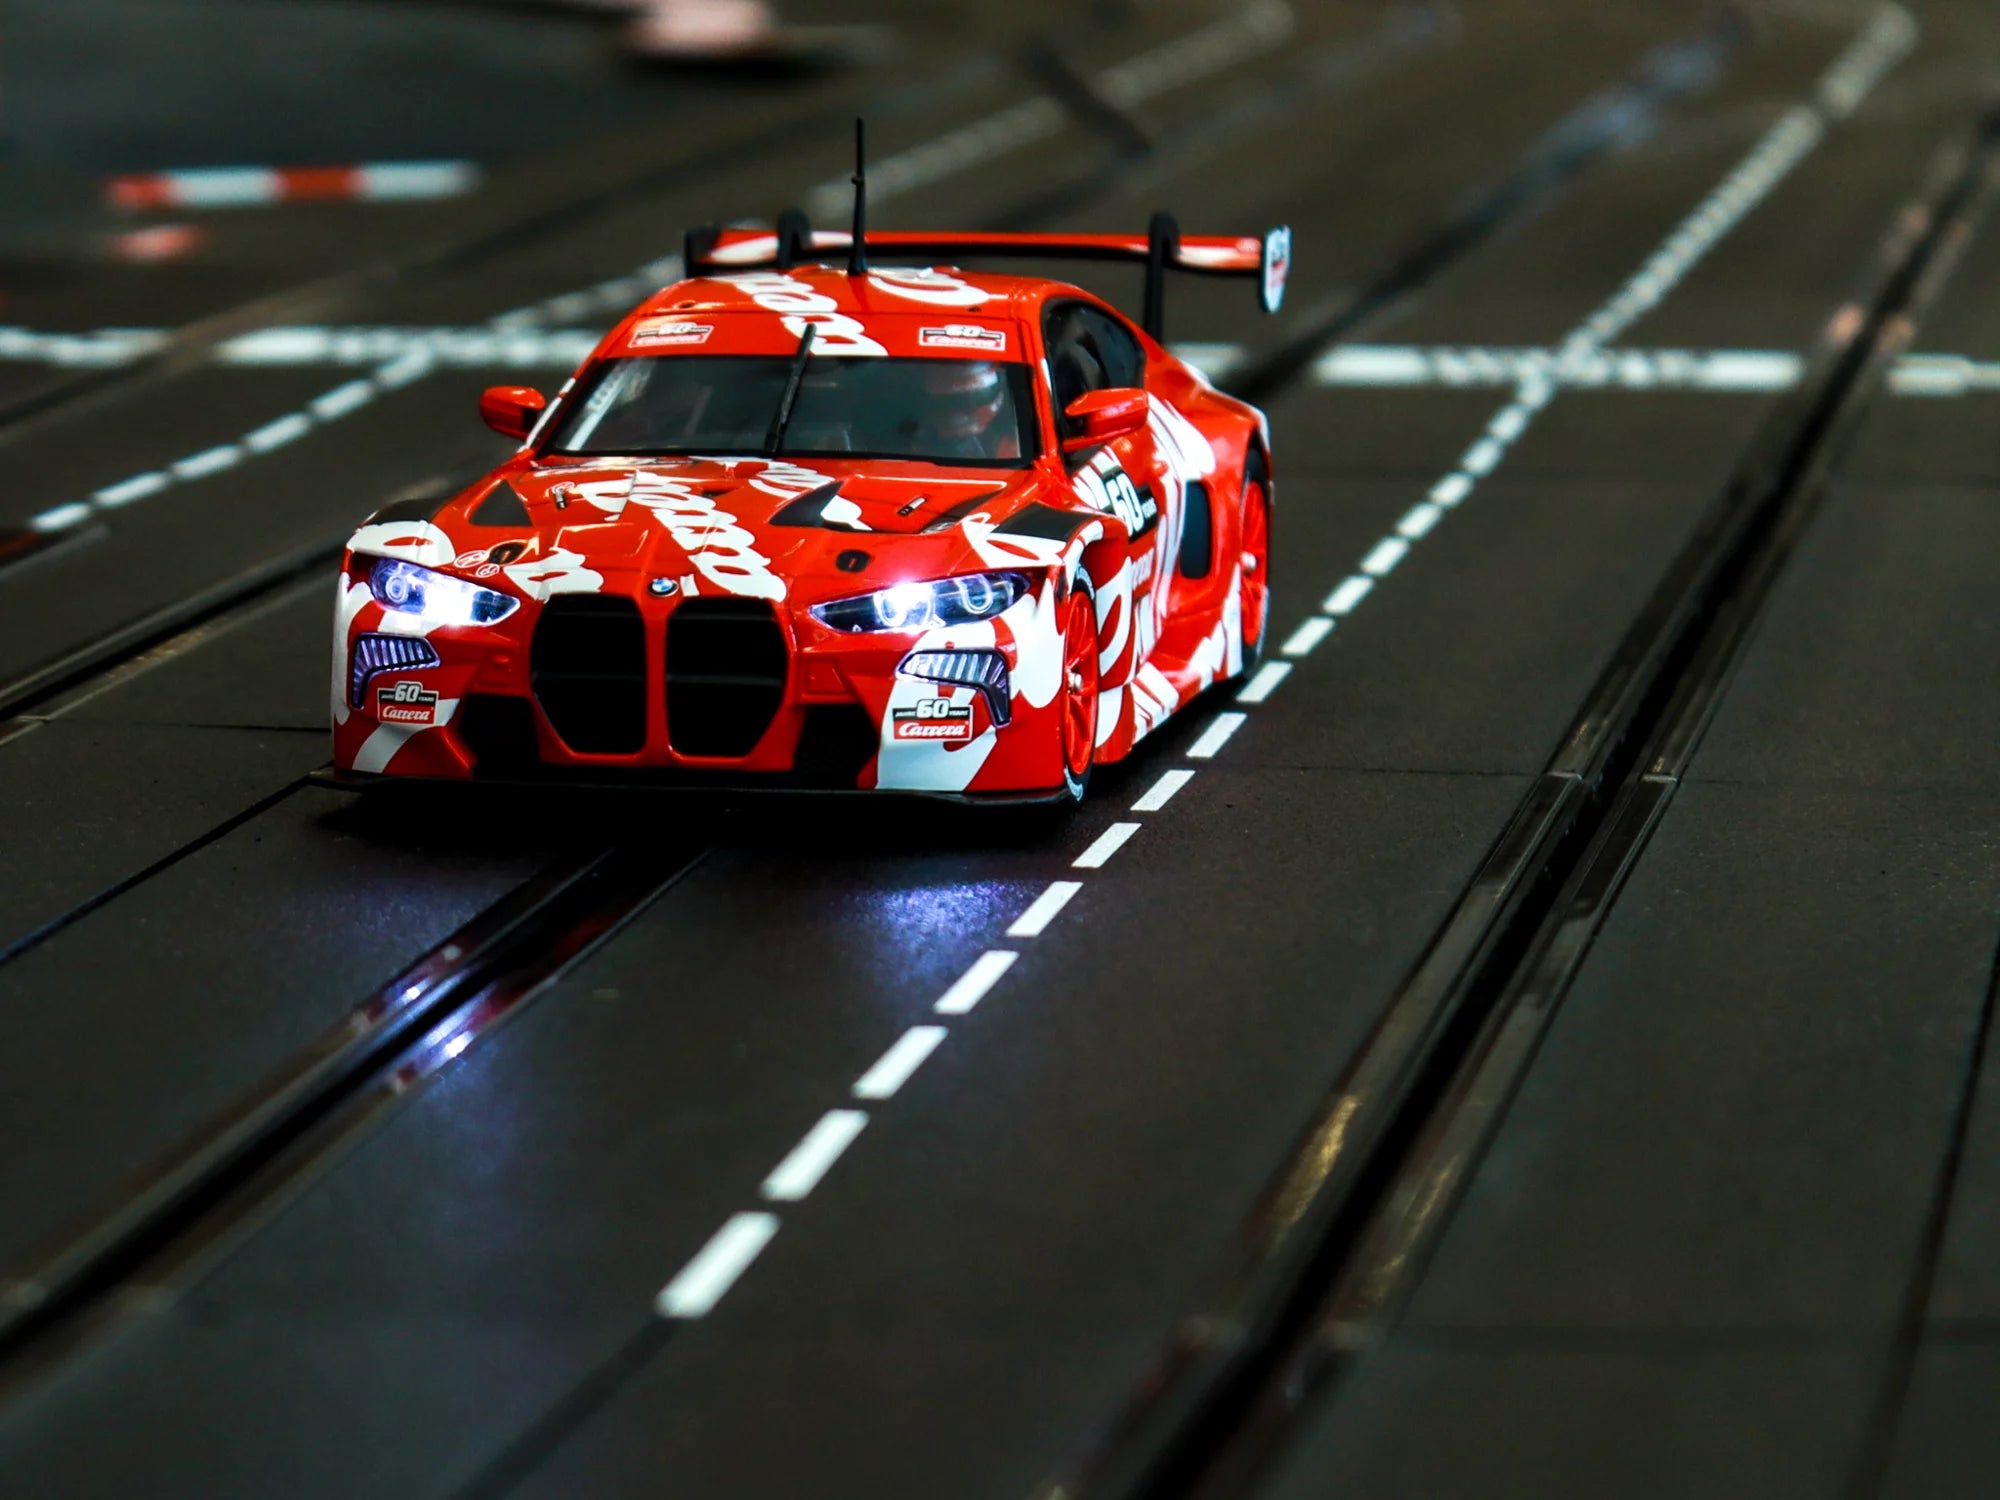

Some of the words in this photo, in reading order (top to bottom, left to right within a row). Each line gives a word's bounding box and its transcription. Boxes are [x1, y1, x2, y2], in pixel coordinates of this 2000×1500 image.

[395, 684, 420, 702] 60
[383, 705, 430, 720] Carrera
[916, 699, 950, 718] 60
[899, 722, 965, 736] Carrera
